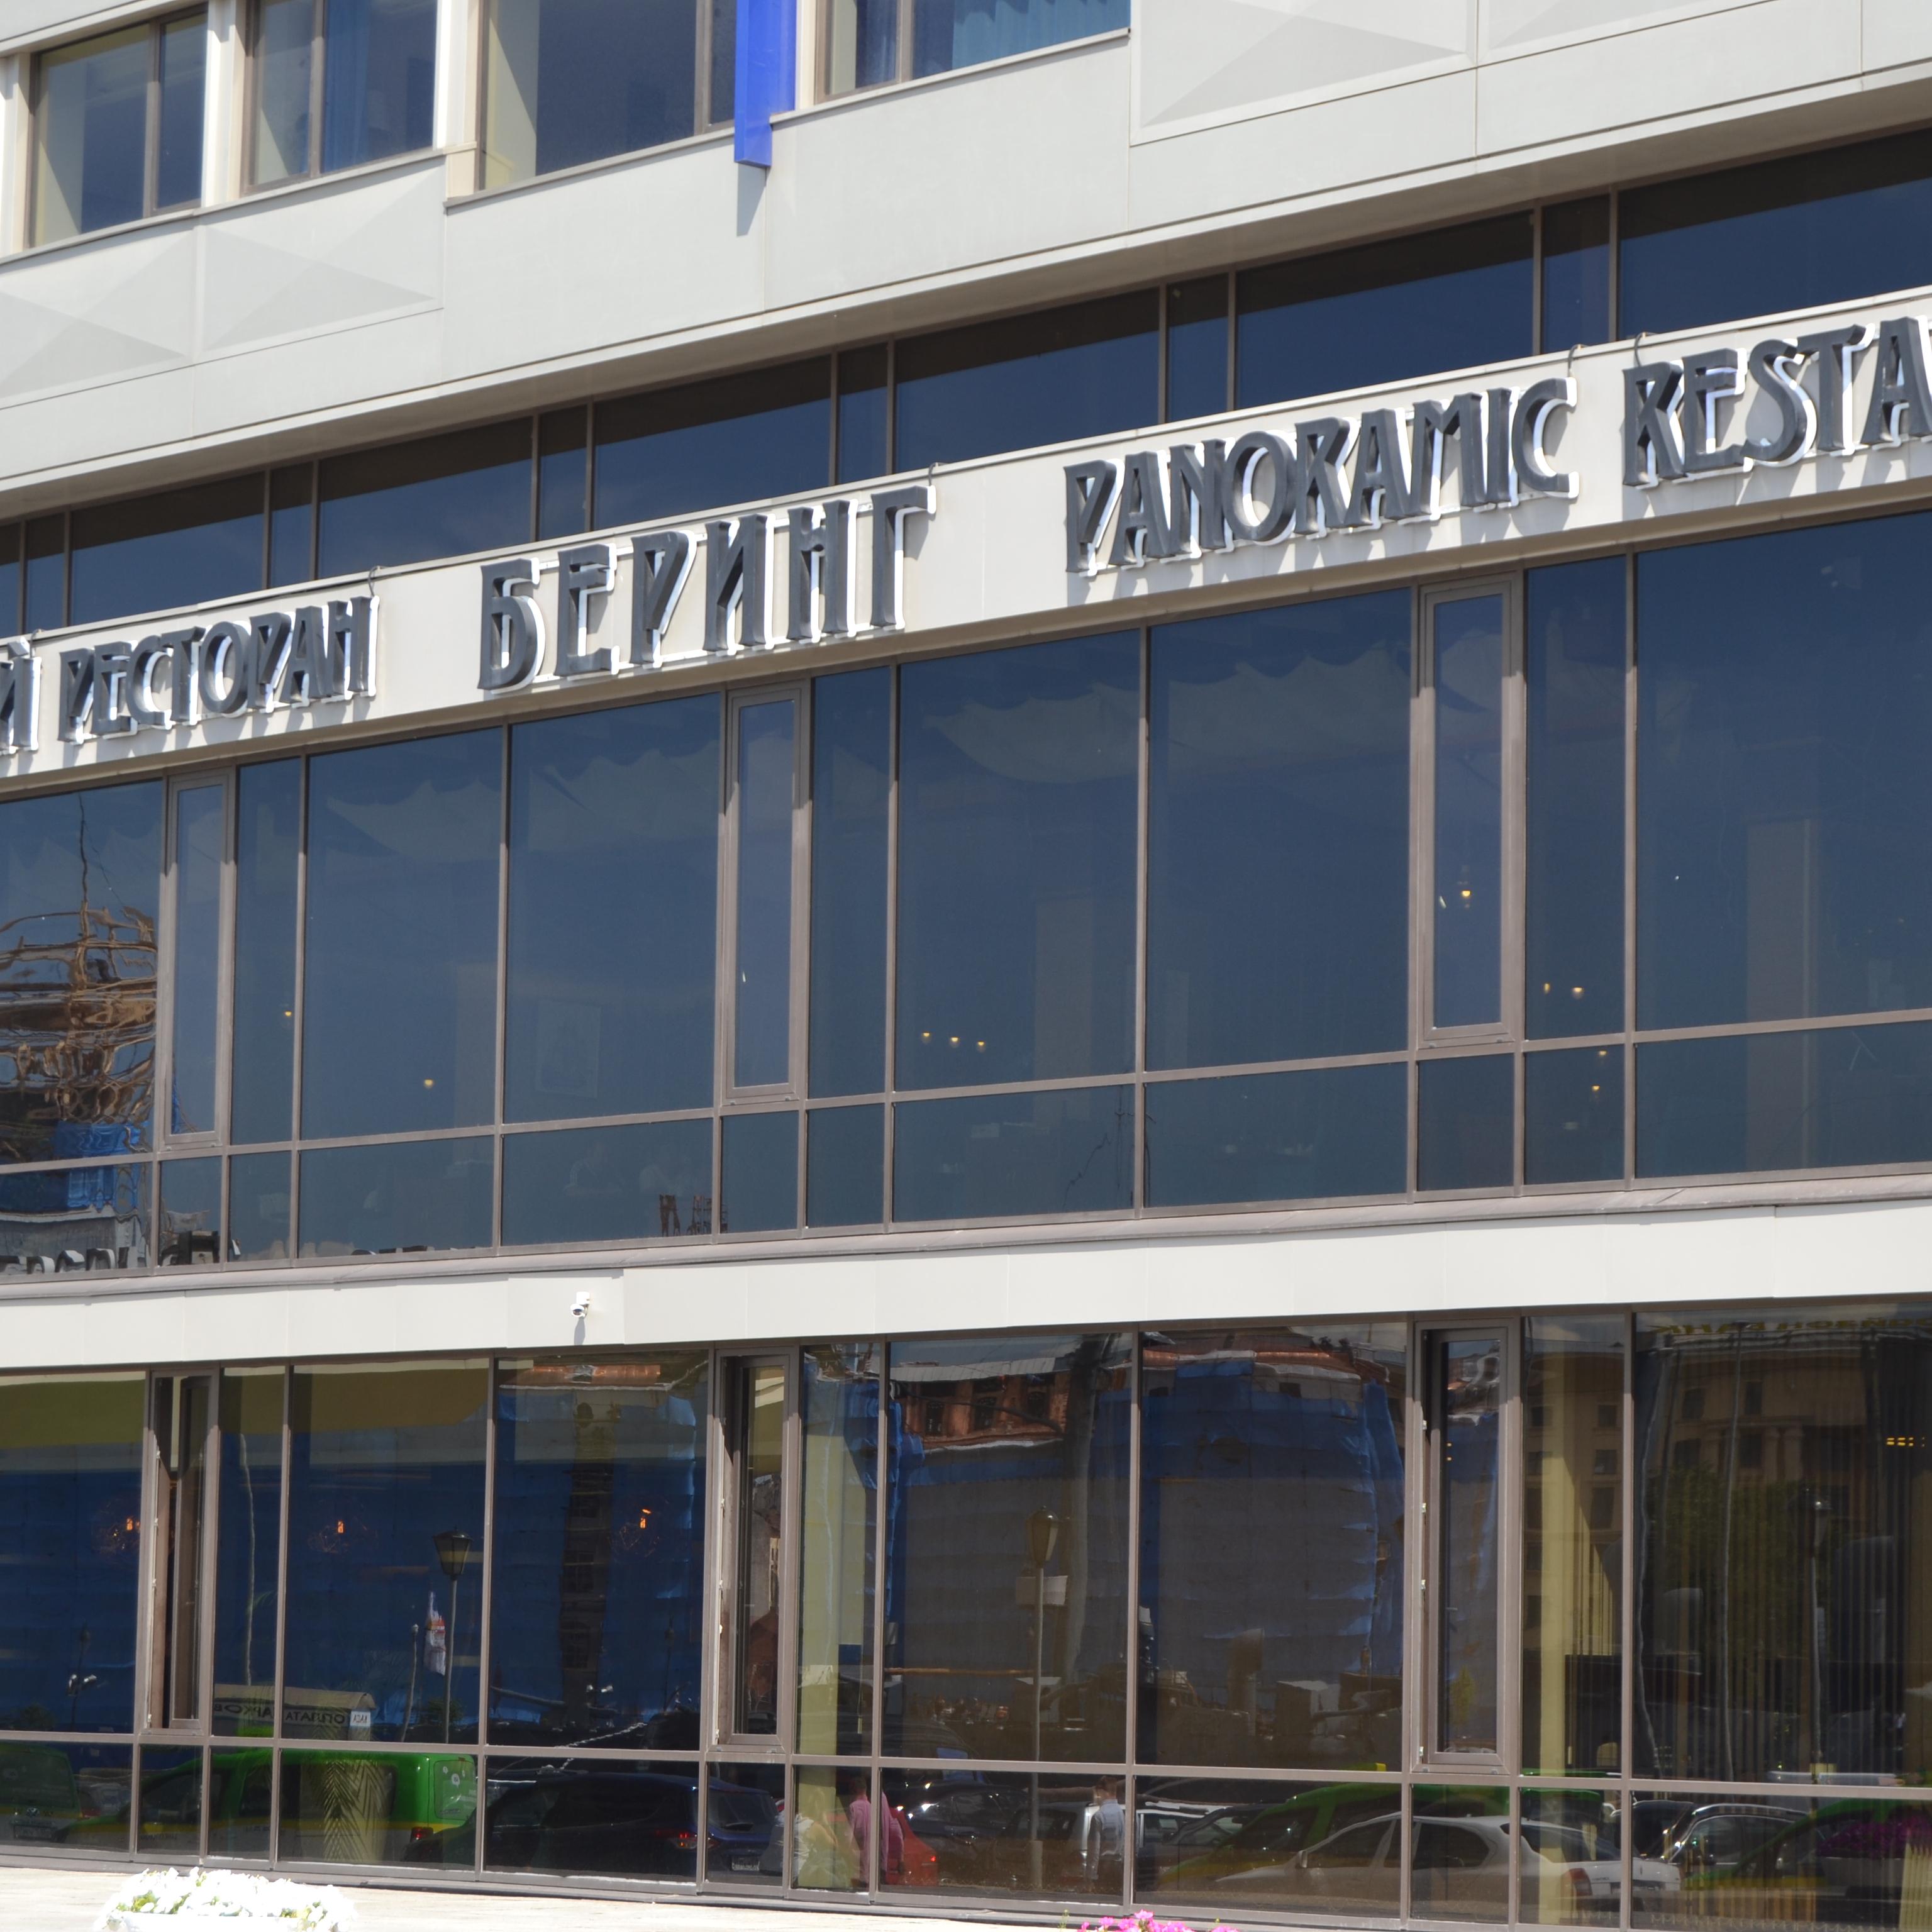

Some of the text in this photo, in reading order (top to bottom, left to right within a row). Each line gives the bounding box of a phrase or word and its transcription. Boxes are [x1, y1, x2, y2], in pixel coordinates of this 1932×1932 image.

[1063, 314, 1932, 577] PANORAMIC RESTA
[58, 595, 380, 745] РЕСТОРАН
[477, 485, 937, 694] БЕРИНГ
